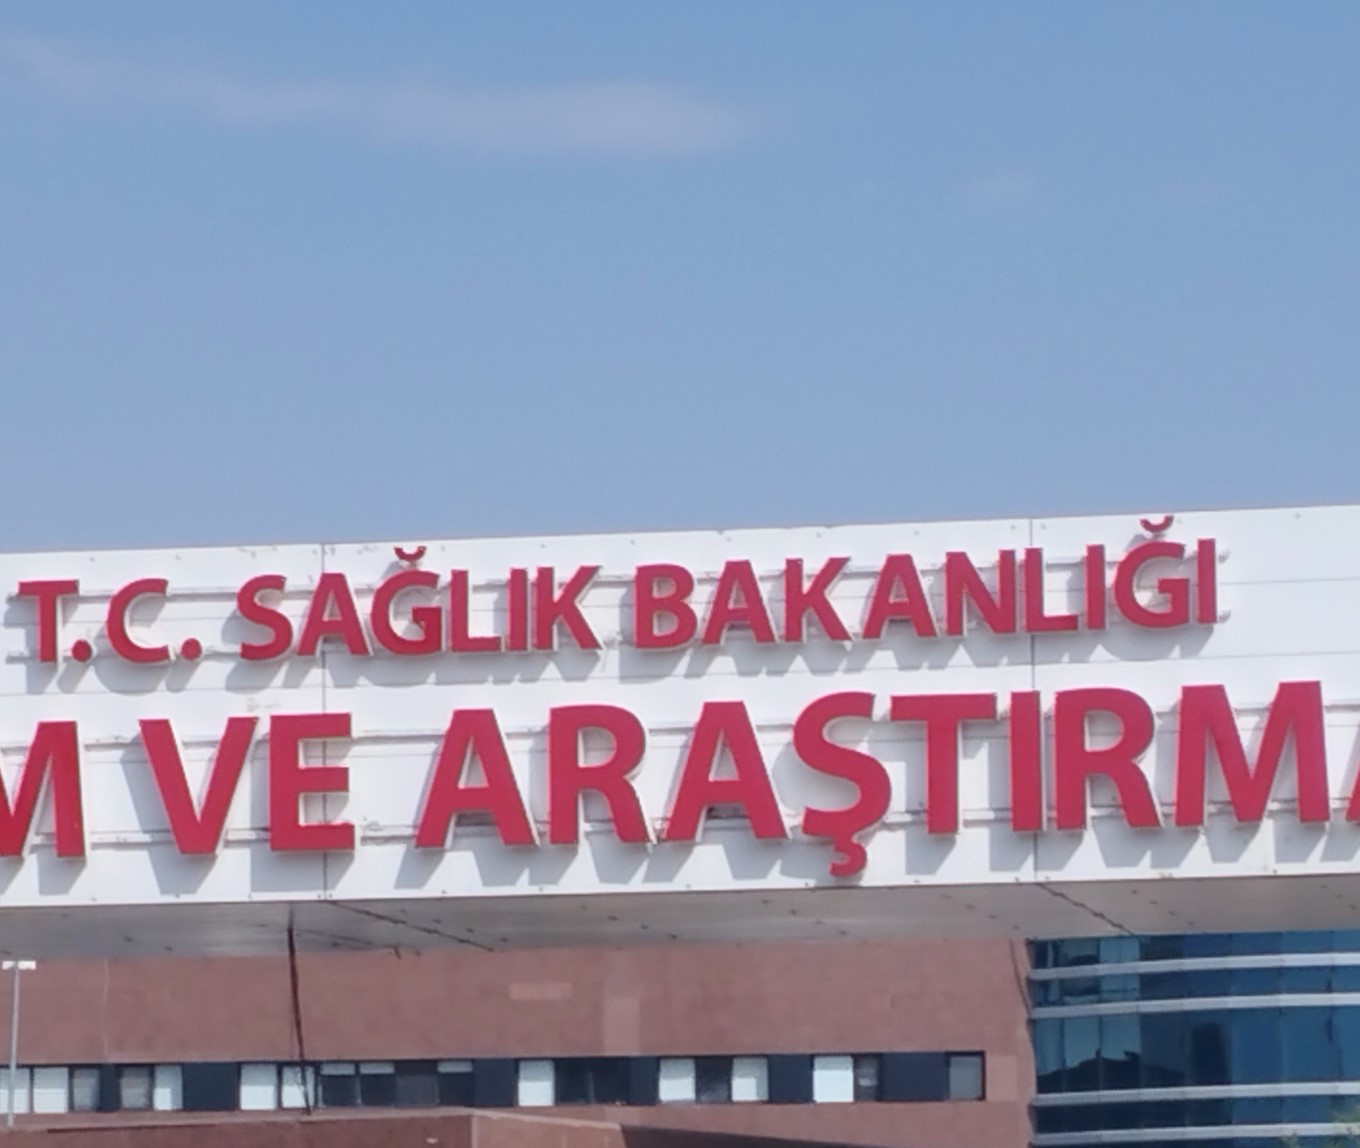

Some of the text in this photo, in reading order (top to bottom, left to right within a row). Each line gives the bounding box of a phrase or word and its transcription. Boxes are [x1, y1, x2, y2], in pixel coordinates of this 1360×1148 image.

[17, 514, 1218, 665] T.C. SAĞLIK BAKANLIĞI
[138, 711, 356, 857] VE
